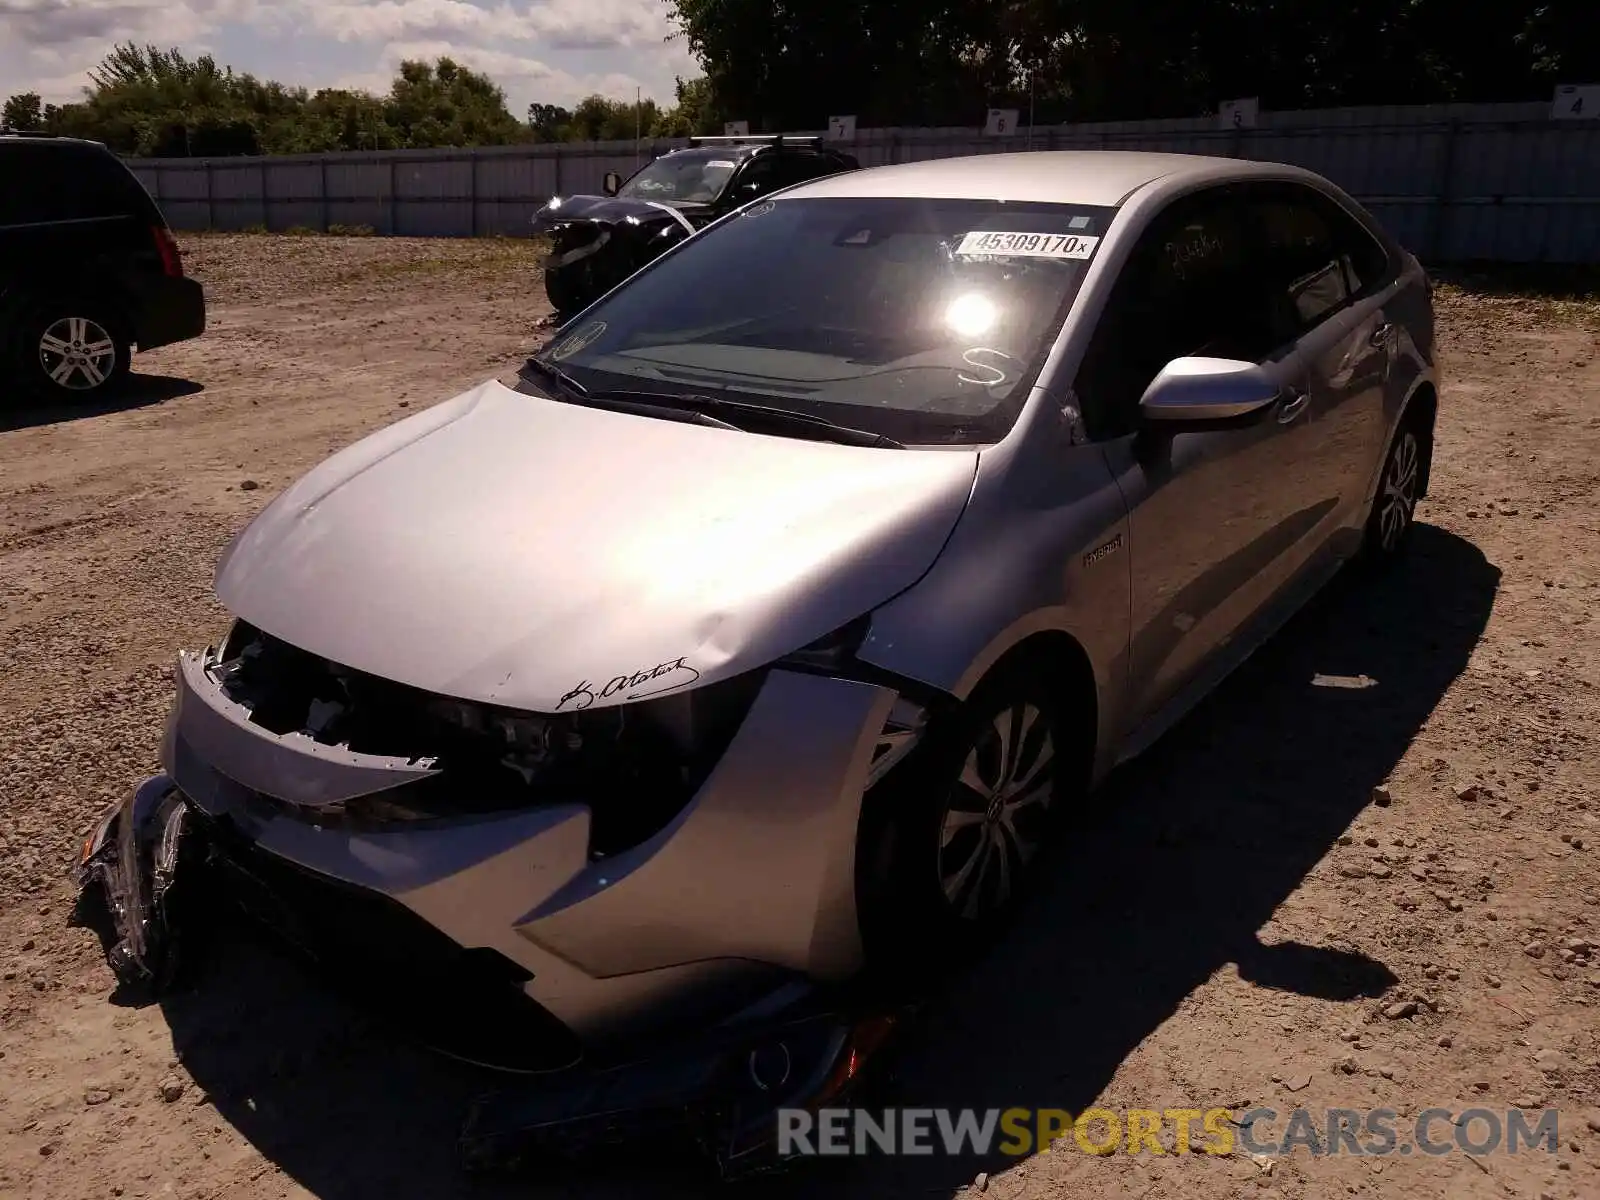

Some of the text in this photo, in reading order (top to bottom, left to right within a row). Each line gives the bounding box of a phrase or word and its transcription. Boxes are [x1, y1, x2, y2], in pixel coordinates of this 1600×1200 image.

[1570, 97, 1584, 115] 4
[836, 125, 846, 136] 7
[958, 347, 1011, 385] S
